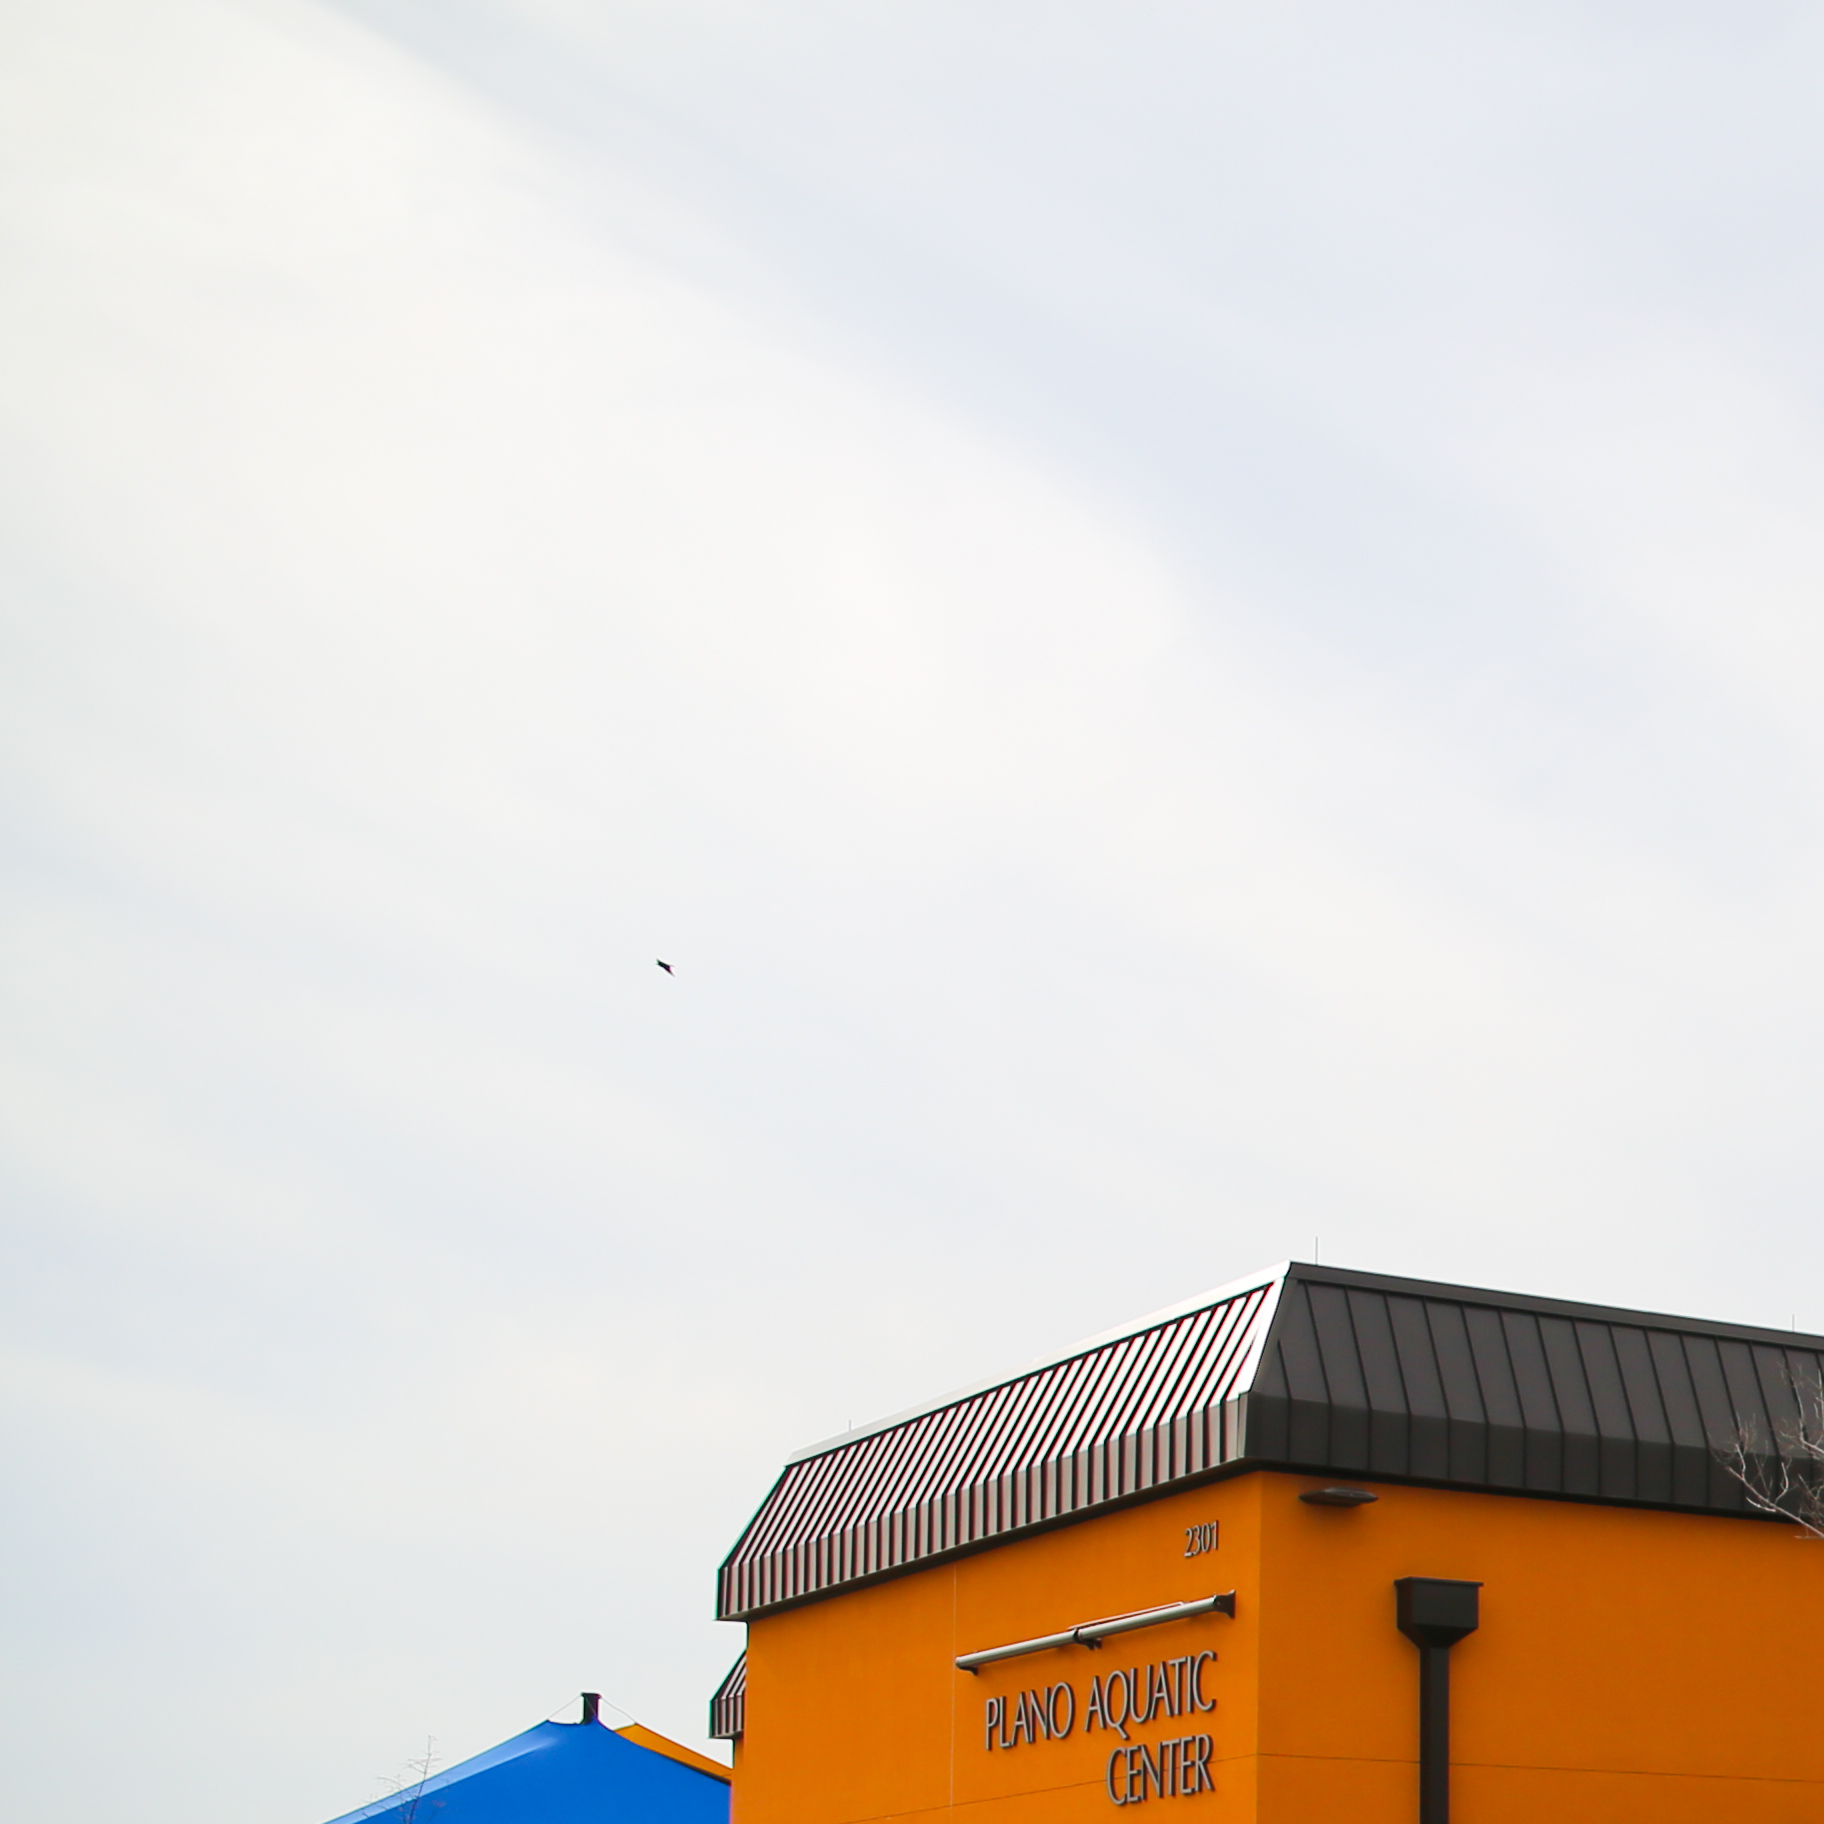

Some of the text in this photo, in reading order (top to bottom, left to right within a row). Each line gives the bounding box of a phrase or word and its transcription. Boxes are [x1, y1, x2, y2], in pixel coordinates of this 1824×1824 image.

[1184, 1520, 1219, 1558] 2301
[985, 1650, 1217, 1751] PLANO AQUATIC
[1106, 1733, 1214, 1806] CENTER
